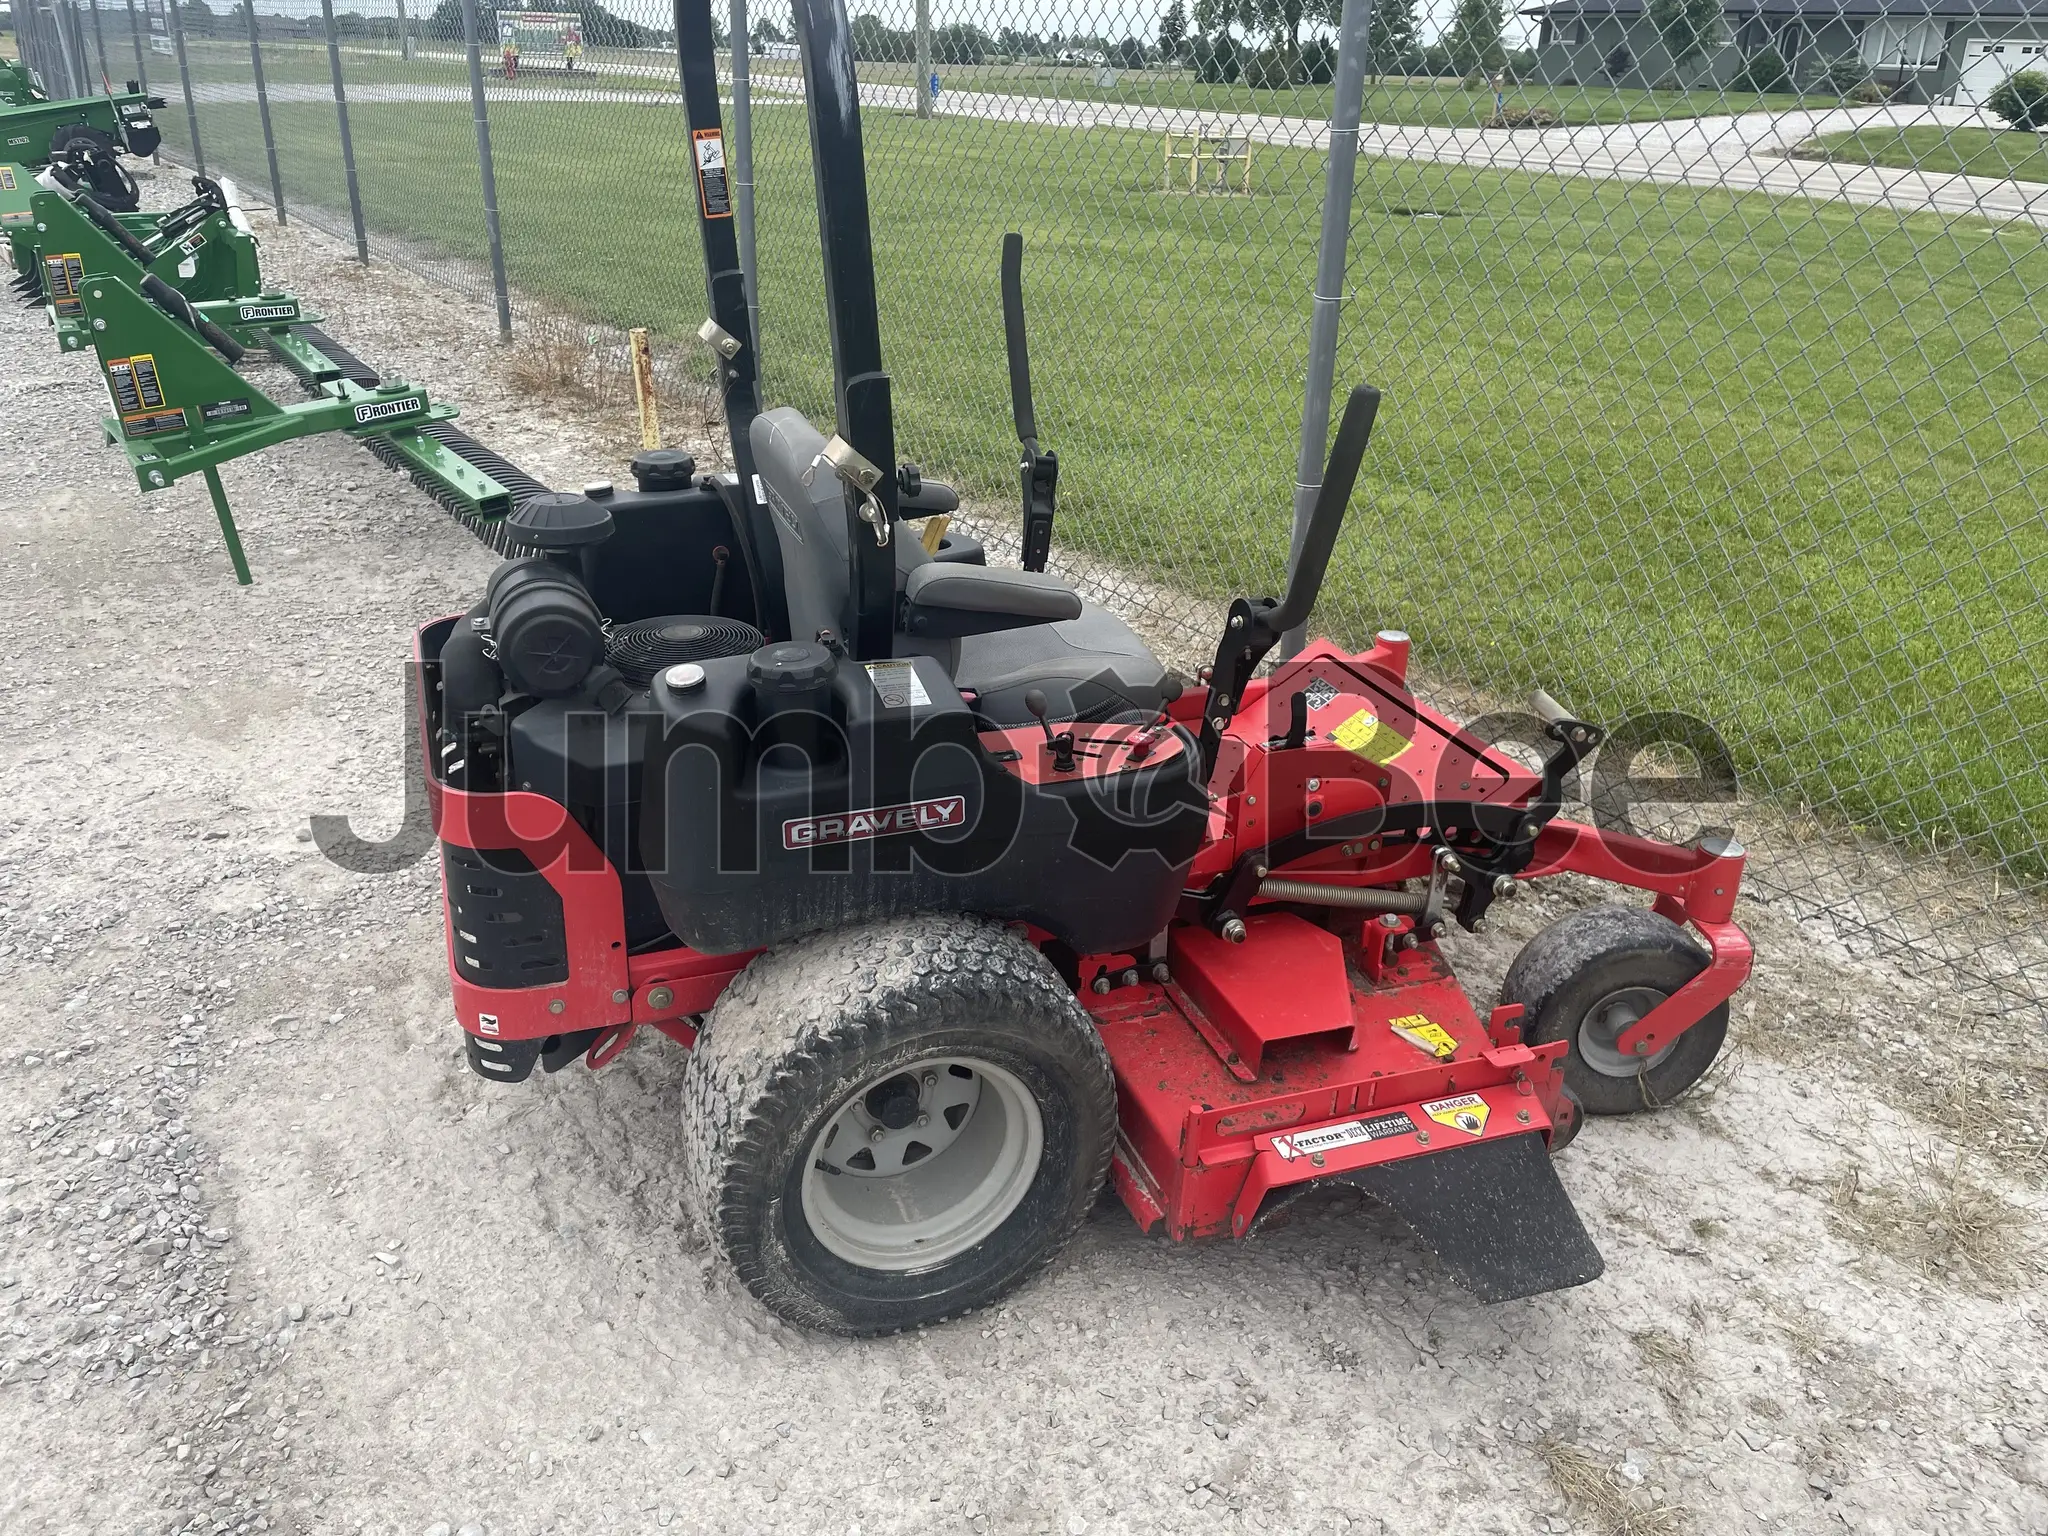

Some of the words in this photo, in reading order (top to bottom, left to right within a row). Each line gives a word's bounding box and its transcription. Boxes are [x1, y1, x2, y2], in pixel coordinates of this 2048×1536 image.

[242, 306, 293, 318] FRONTIER
[356, 399, 419, 421] FRONTIER
[791, 801, 958, 844] GRAVELY
[1429, 1096, 1479, 1111] DANGER
[1365, 1116, 1412, 1132] LIFETIME
[1370, 1123, 1415, 1138] WARRANTY
[1346, 1126, 1367, 1139] DECK
